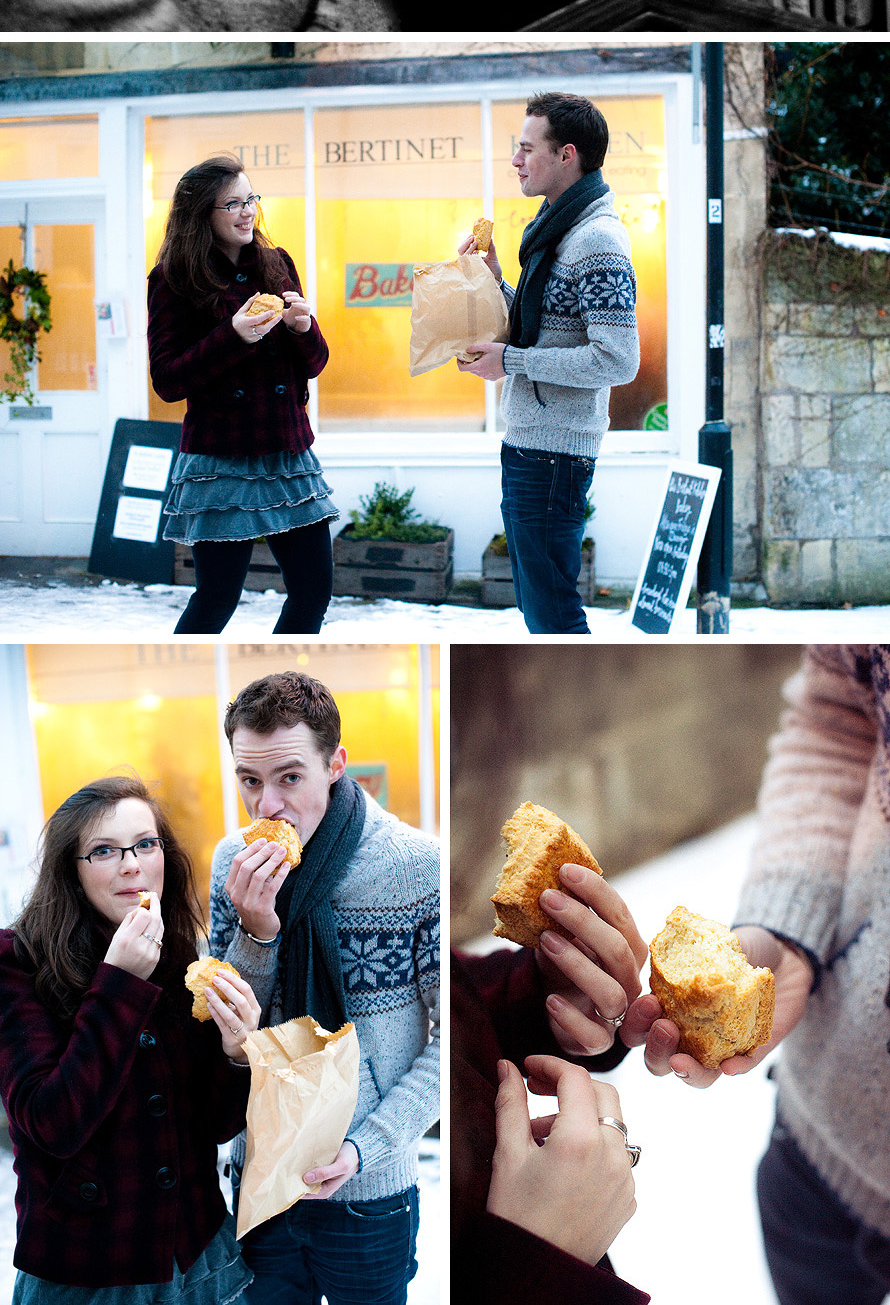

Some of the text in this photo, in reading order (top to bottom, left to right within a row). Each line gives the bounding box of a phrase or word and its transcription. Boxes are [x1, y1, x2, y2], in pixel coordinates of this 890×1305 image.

[233, 136, 463, 166] THE BERTINET
[711, 204, 721, 218] 2
